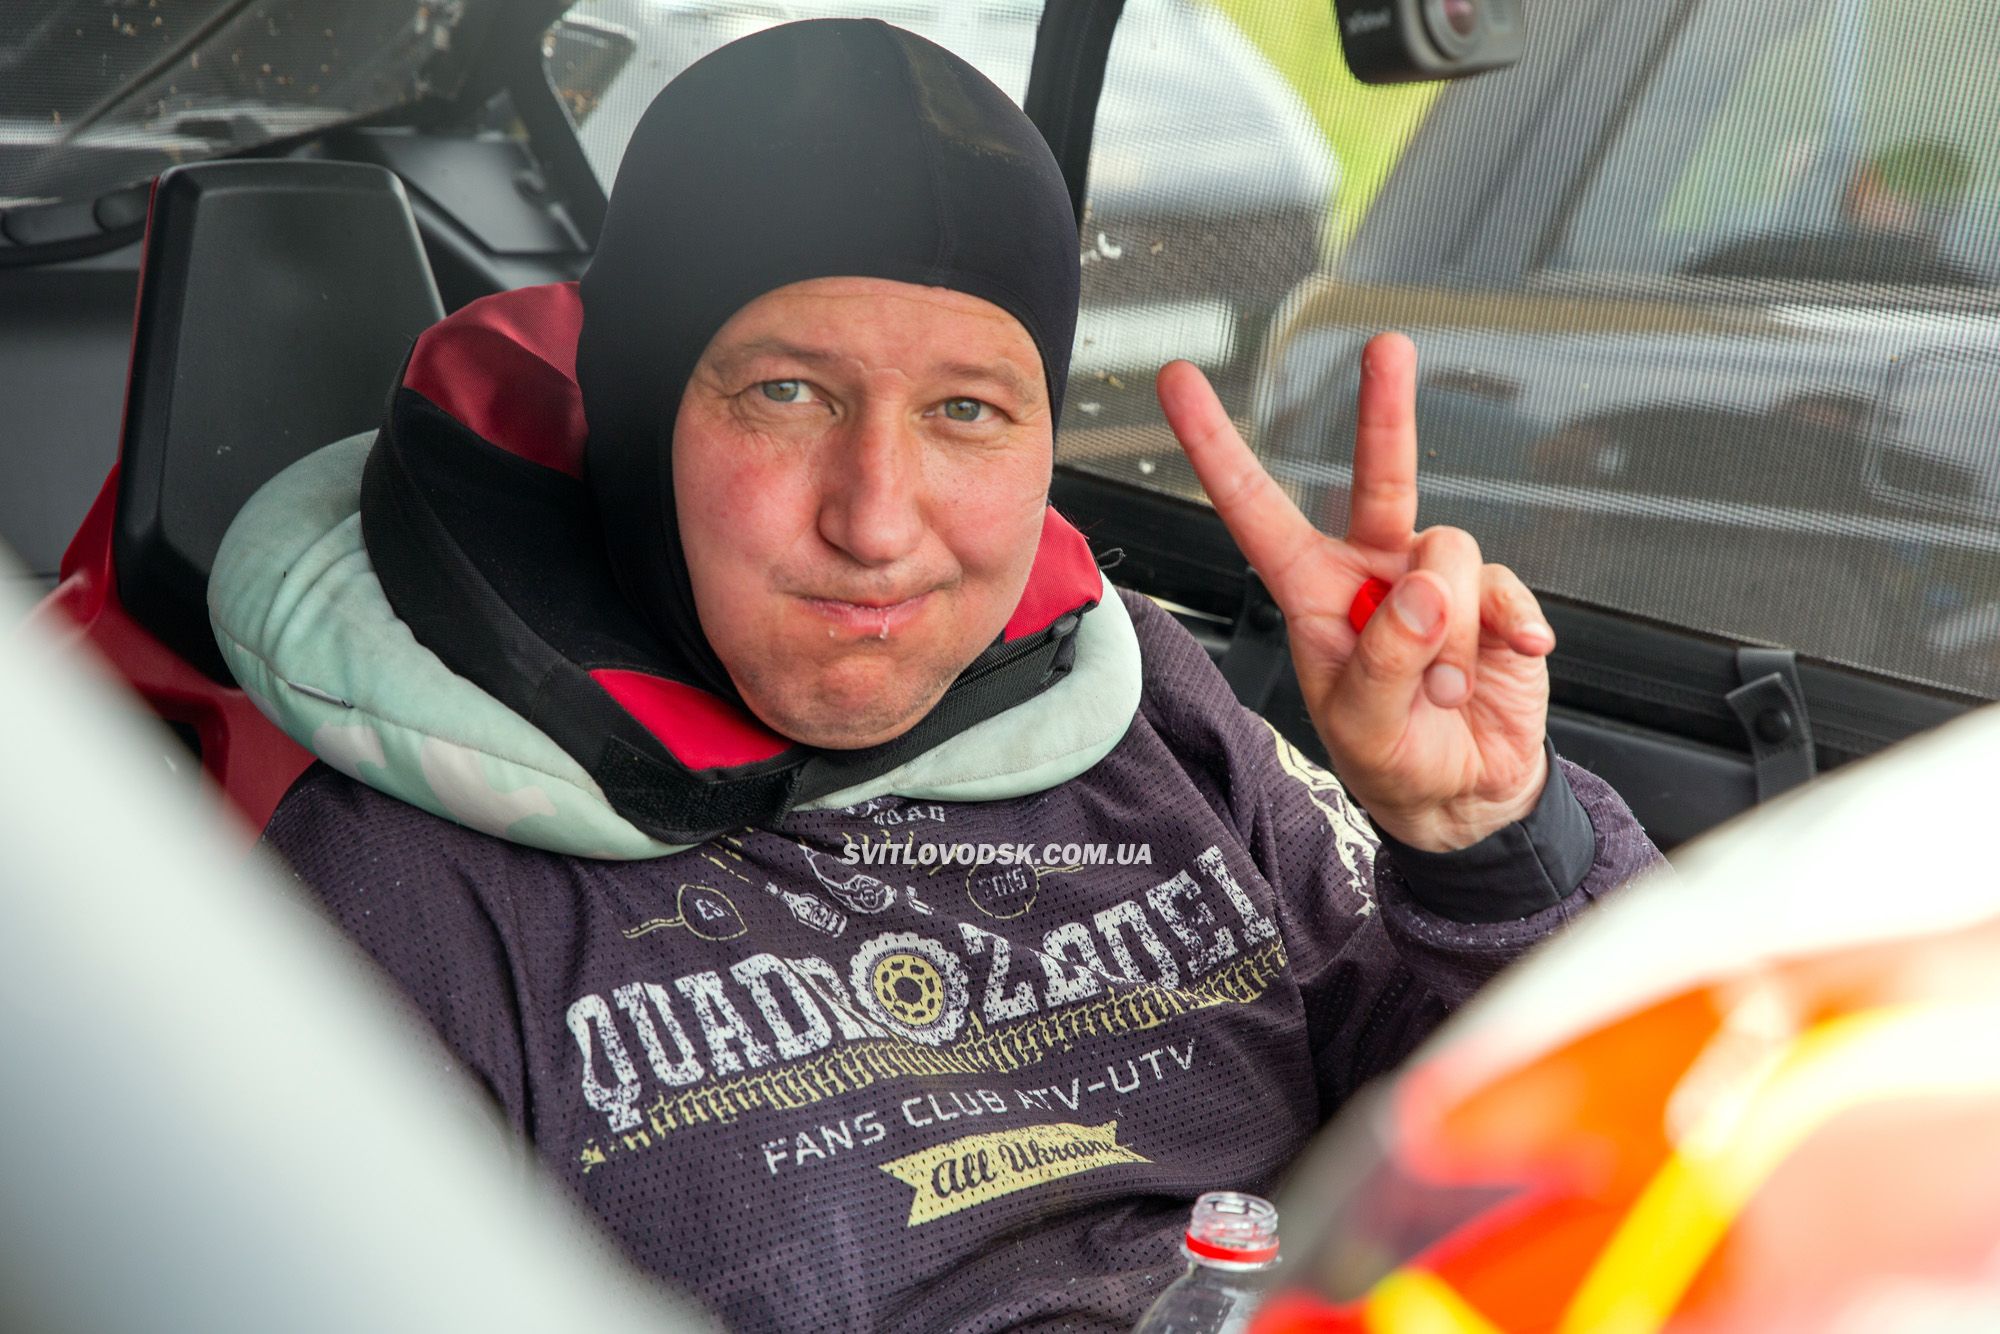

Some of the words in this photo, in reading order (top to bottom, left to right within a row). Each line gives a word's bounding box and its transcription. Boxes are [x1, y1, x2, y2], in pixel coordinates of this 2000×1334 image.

[761, 1110, 887, 1175] FANS
[900, 1088, 1009, 1128] CLUB
[1014, 1037, 1197, 1112] ATV-UTV
[930, 1148, 998, 1199] All
